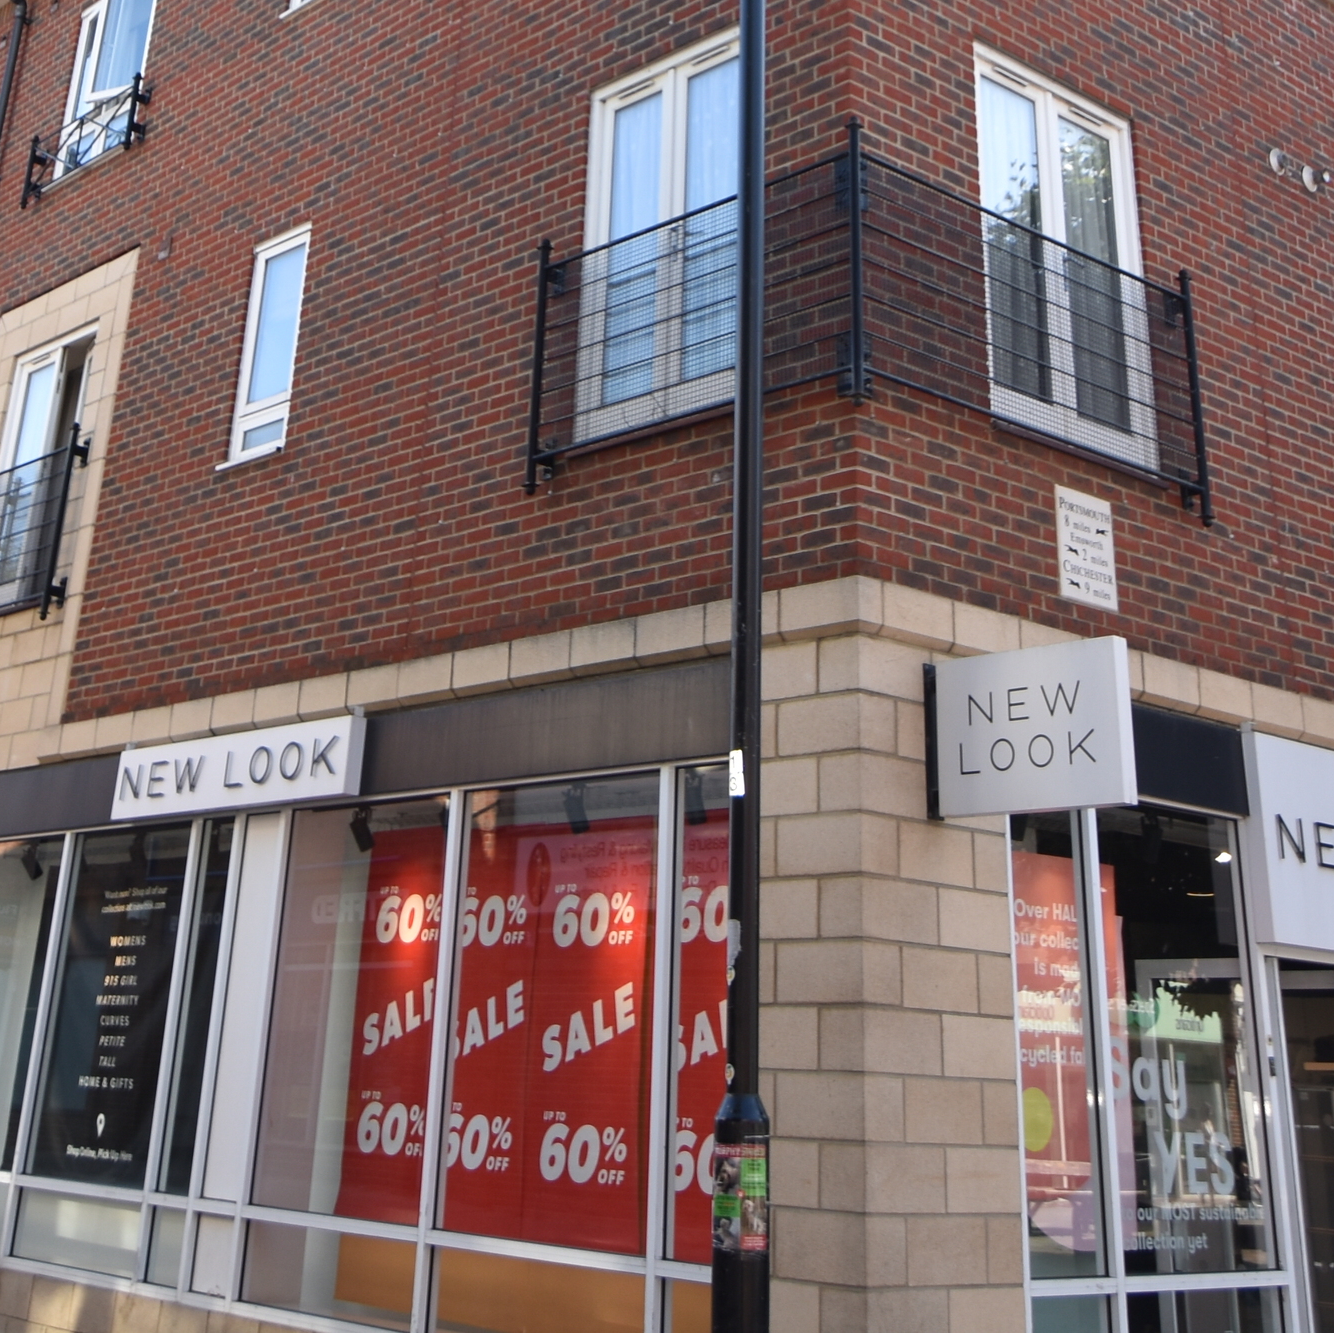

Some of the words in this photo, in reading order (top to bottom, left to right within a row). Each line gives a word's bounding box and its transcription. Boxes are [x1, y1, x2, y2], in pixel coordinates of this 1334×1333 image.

[1073, 521, 1091, 533] miles
[1082, 548, 1088, 561] 2
[1090, 554, 1109, 567] miles
[1063, 559, 1114, 585] CHICHESTER
[1084, 582, 1090, 594] 9
[1093, 588, 1111, 600] miles
[968, 680, 1080, 726] NEW
[959, 728, 1096, 775] LOOK
[119, 755, 206, 801] NEW
[223, 735, 340, 788] LOOK
[555, 884, 565, 893] UP
[566, 883, 577, 893] TO
[688, 876, 699, 885] TO
[390, 886, 399, 894] TO
[467, 886, 476, 895] TO
[681, 885, 728, 943] 60
[1014, 898, 1049, 919] Over
[1052, 903, 1077, 922] HAL
[552, 891, 635, 948] 60%
[110, 935, 147, 947] WOMENS
[503, 931, 525, 945] OFF
[608, 930, 633, 945] OFF
[1039, 932, 1079, 950] collec
[115, 955, 137, 967] MENS
[1034, 958, 1047, 976] is
[1050, 961, 1080, 977] mad
[104, 975, 119, 986] 915
[96, 995, 140, 1006] MATERNITY
[100, 1015, 130, 1027] CURVES
[542, 981, 635, 1072] SALE
[1018, 1017, 1083, 1037] esponsibl
[99, 1035, 126, 1047] PETITE
[99, 1055, 116, 1067] TALL
[1020, 1044, 1066, 1067] cycled
[78, 1075, 101, 1088] HOME
[110, 1078, 134, 1090] GIFTS
[371, 1091, 381, 1100] TO
[453, 1102, 462, 1112] TO
[543, 1111, 554, 1121] UP
[555, 1111, 566, 1121] TO
[682, 1118, 694, 1127] TO
[539, 1123, 627, 1184] 60%
[486, 1156, 510, 1171] OFF
[1154, 1131, 1235, 1196] YES
[597, 1169, 625, 1185] OFF
[1137, 1206, 1158, 1221] our
[1161, 1203, 1196, 1221] MOST
[1188, 1233, 1208, 1254] yet
